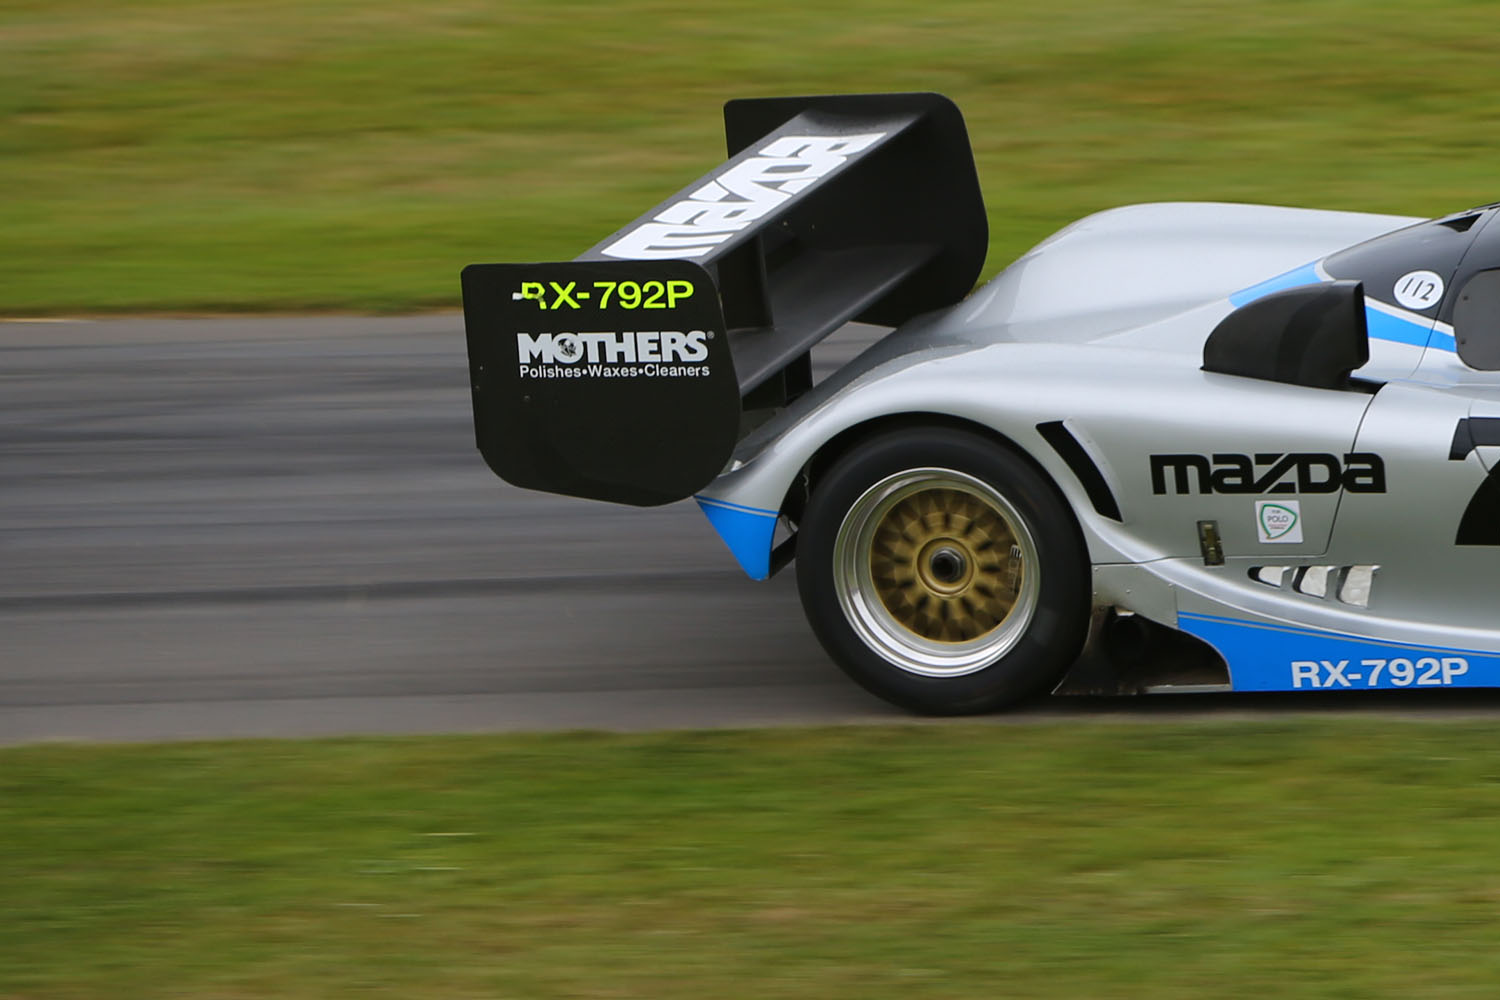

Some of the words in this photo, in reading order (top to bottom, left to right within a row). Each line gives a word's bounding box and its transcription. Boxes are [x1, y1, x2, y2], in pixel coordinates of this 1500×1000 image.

[601, 132, 888, 260] mazda
[519, 280, 694, 310] RX-792P
[1401, 276, 1436, 301] 112
[516, 330, 710, 364] MOTHERS
[1149, 452, 1387, 495] mazda
[1290, 656, 1470, 689] RX-792P
